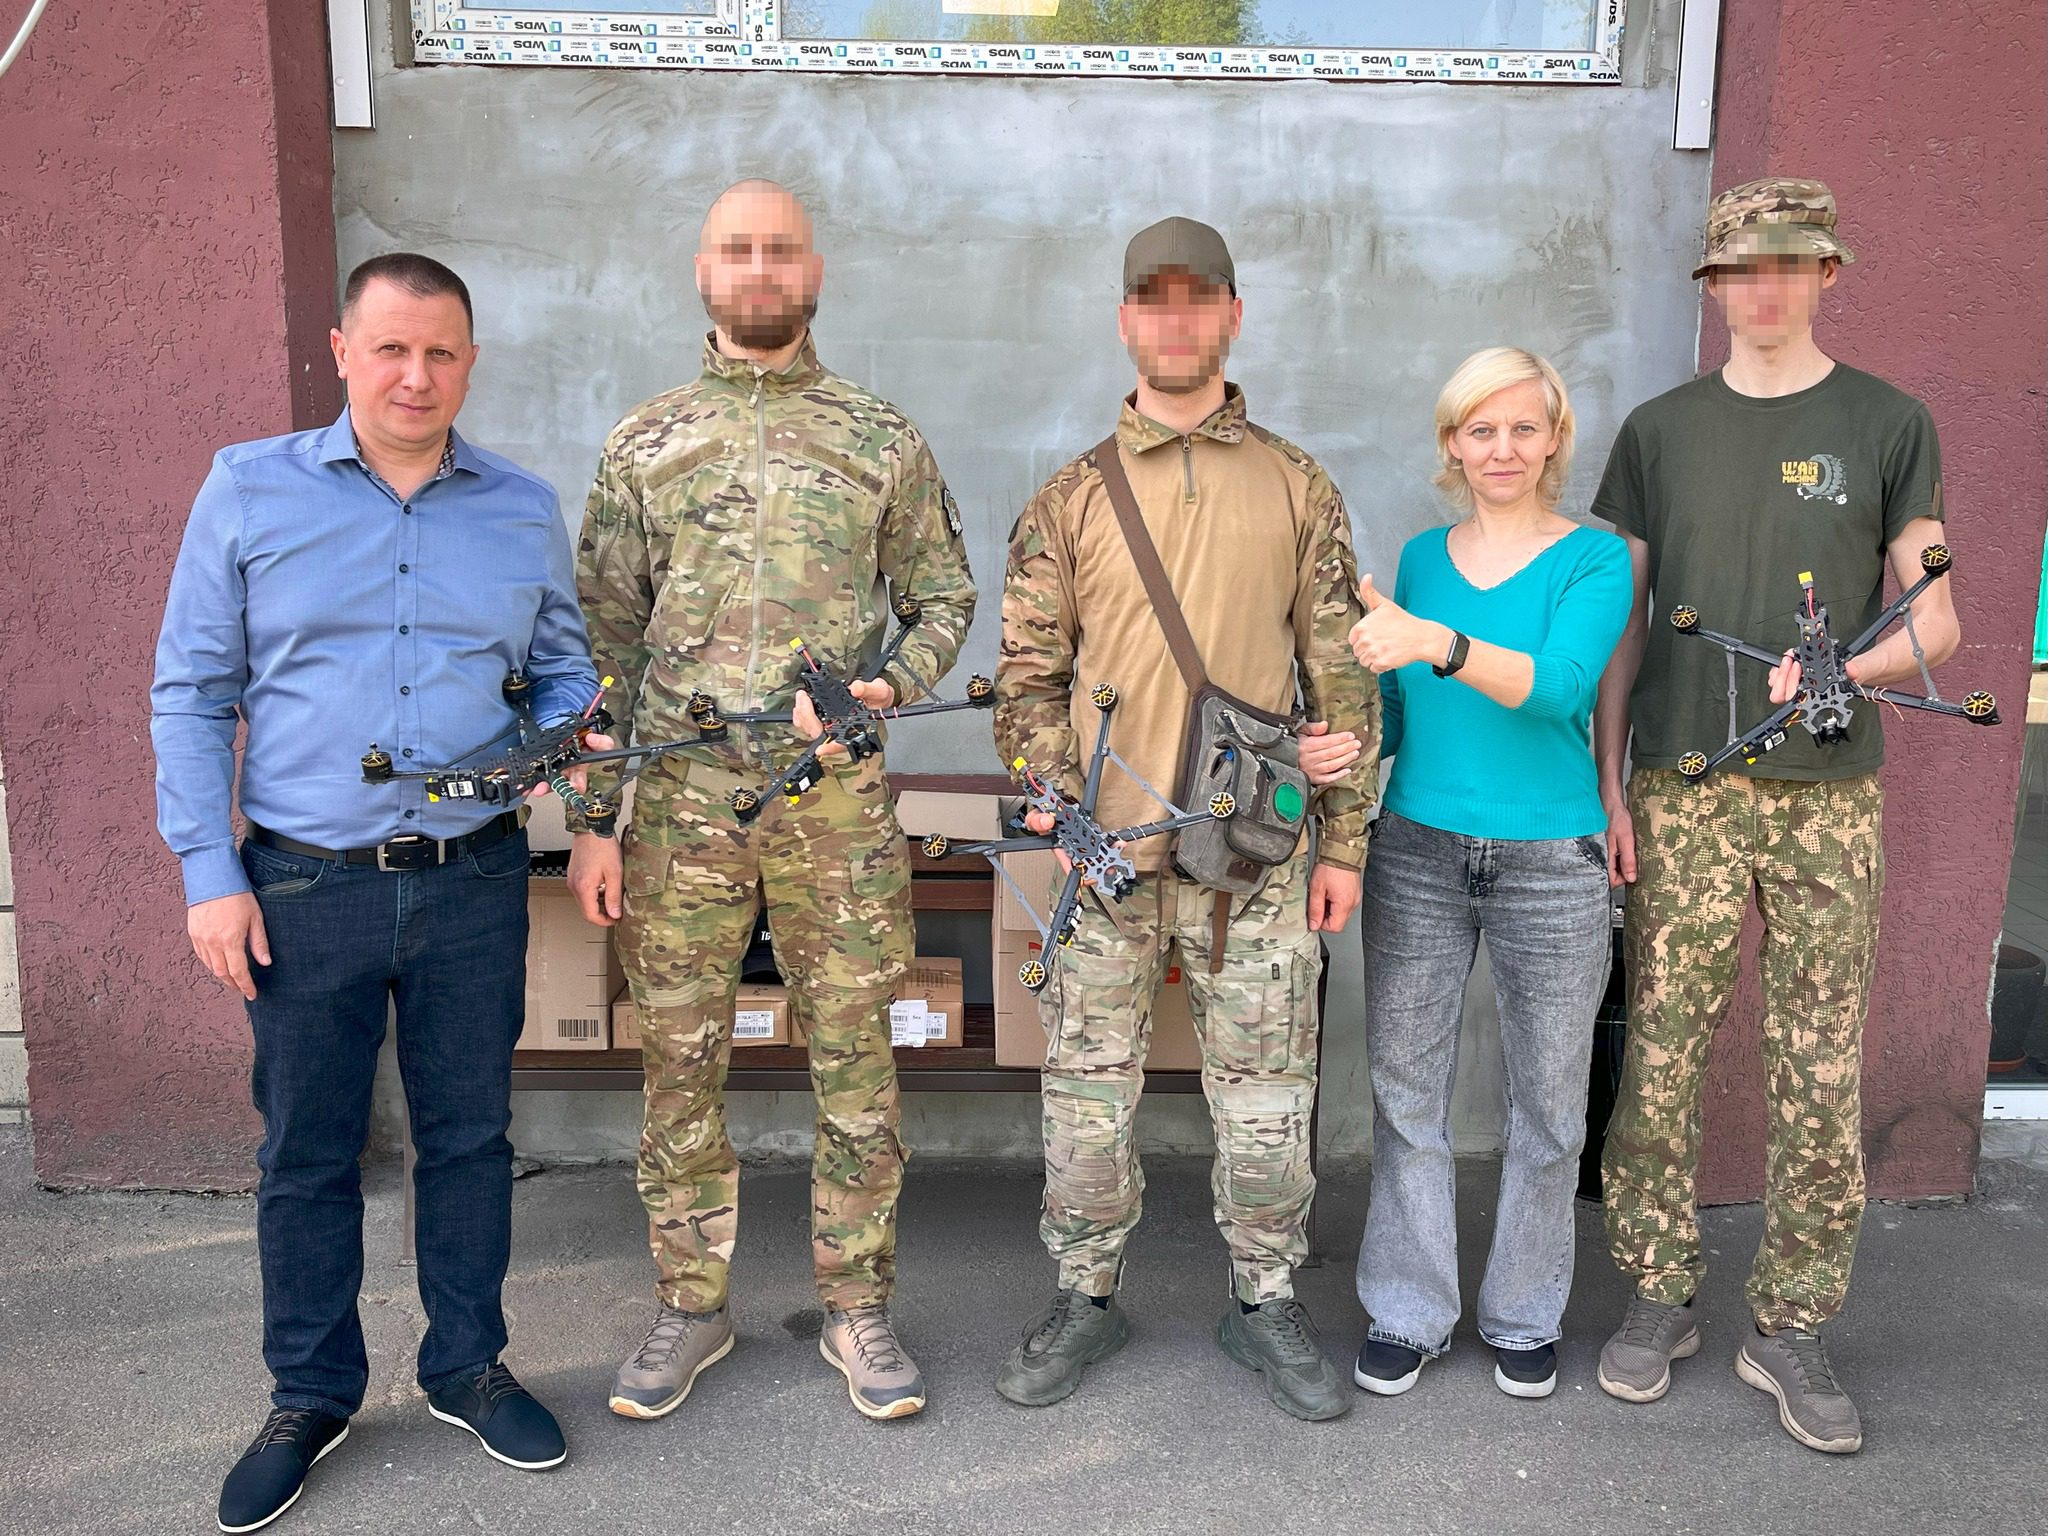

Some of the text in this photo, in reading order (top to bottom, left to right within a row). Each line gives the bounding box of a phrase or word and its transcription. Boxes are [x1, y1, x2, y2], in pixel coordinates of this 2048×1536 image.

[514, 21, 548, 33] WDS
[609, 23, 643, 36] WDS
[513, 40, 547, 51] WDS
[609, 42, 643, 54] WDS
[704, 43, 738, 56] WDS
[800, 45, 833, 57] WDS
[463, 52, 496, 61] WDS
[560, 54, 593, 62] WDS
[894, 47, 927, 59] WDS
[988, 48, 1021, 60] WDS
[1082, 50, 1115, 62] WDS
[1175, 52, 1208, 64] WDS
[656, 56, 689, 64] WDS
[751, 58, 783, 66] WDS
[846, 59, 878, 67] WDS
[1268, 53, 1300, 65] WDS
[1361, 55, 1393, 68] WDS
[1453, 57, 1485, 69] WDS
[1544, 59, 1576, 70] WDS
[940, 61, 972, 69] WDS
[1034, 62, 1065, 70] WDS
[1128, 64, 1159, 72] WDS
[1220, 65, 1251, 73] WDS
[1313, 67, 1344, 75] WDS
[1405, 69, 1436, 77] WDS
[1497, 71, 1528, 79] WDS
[1588, 72, 1620, 80] WDS
